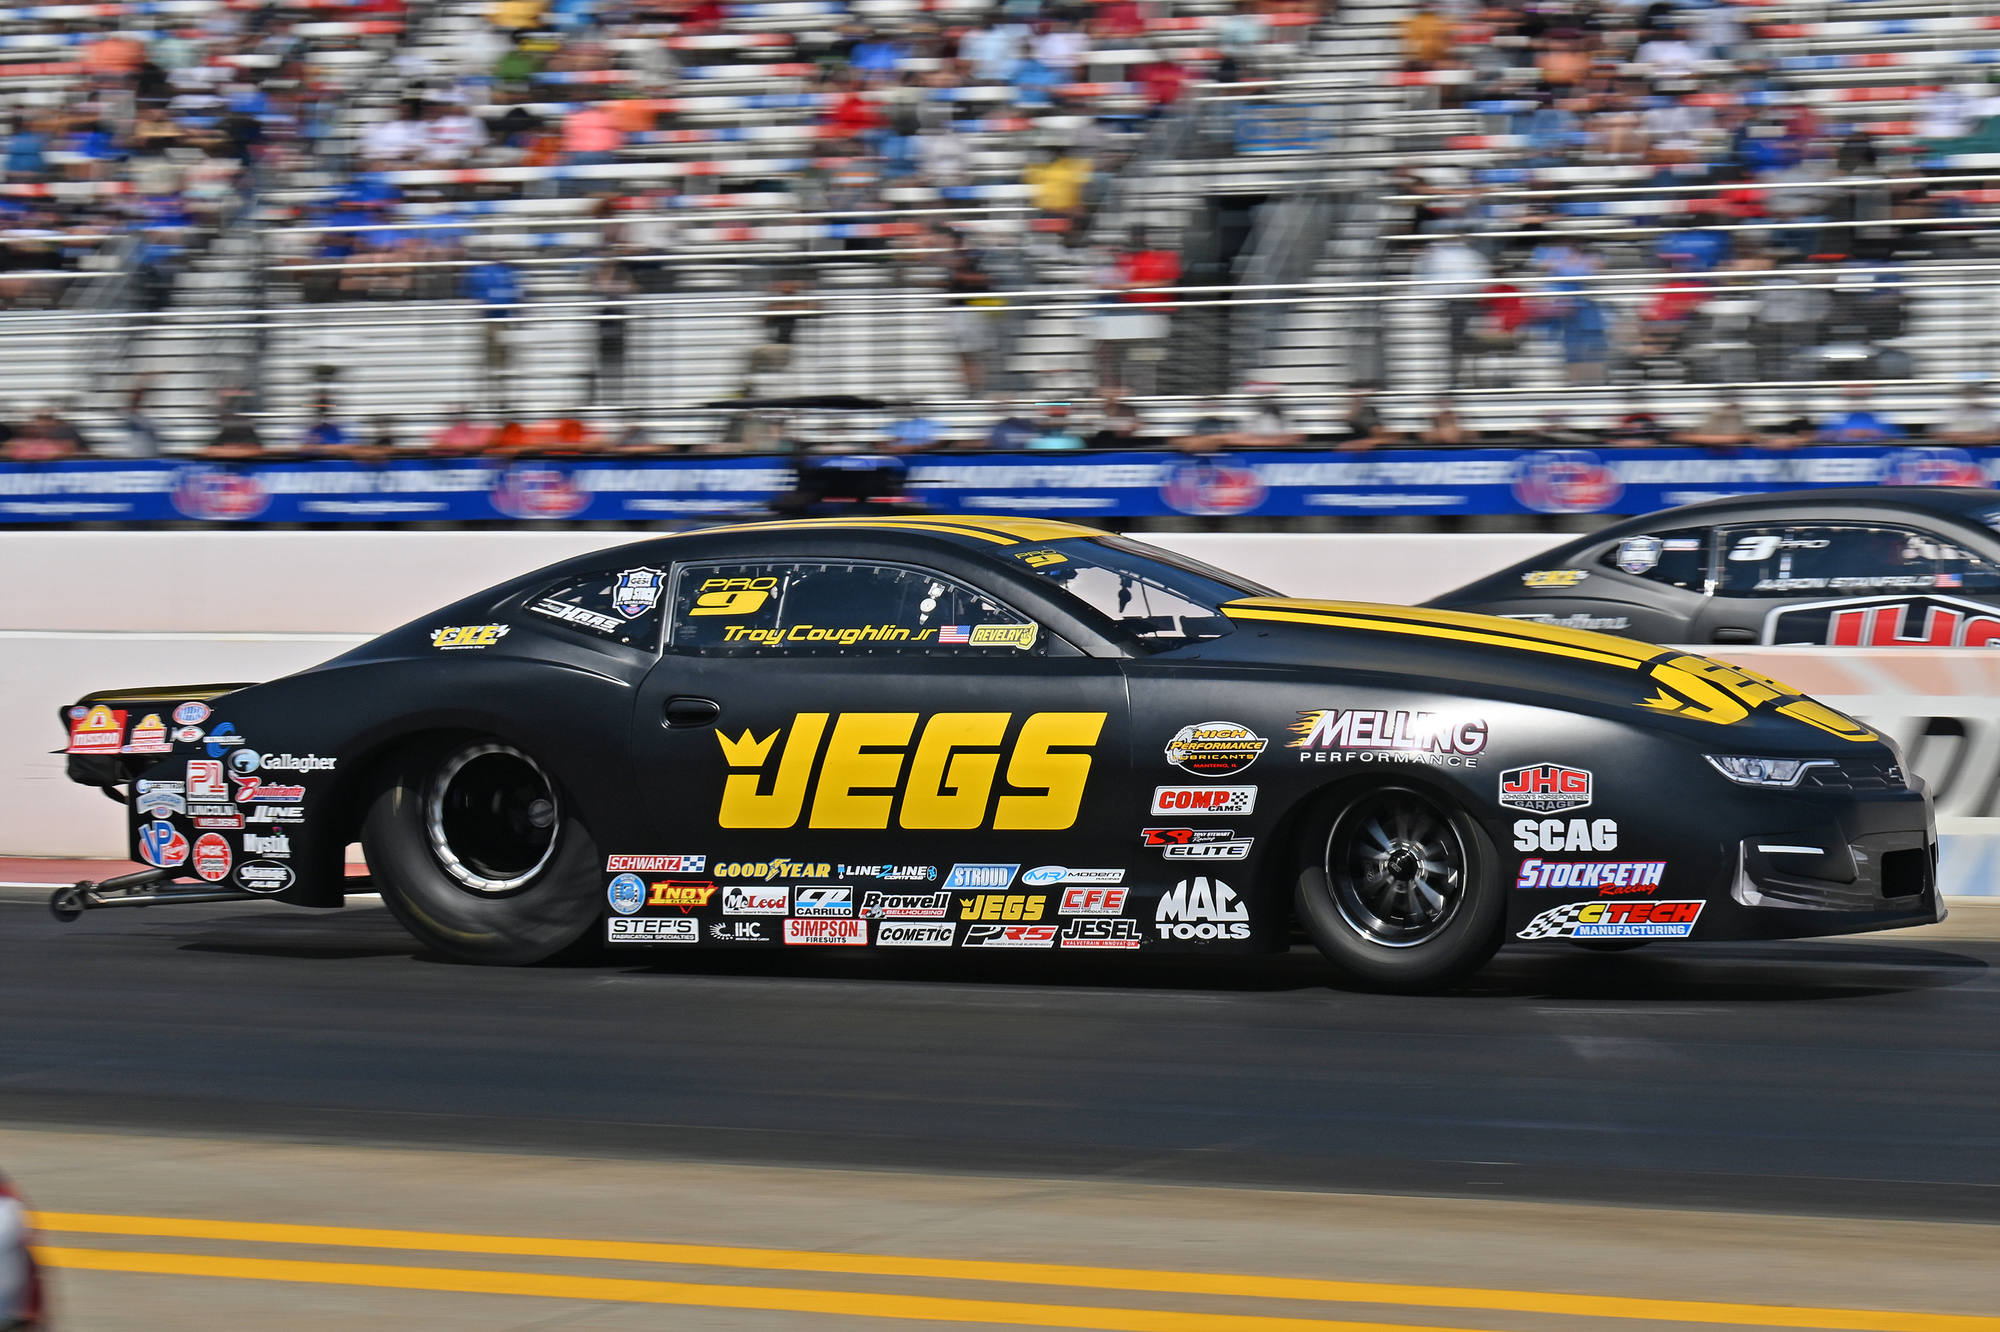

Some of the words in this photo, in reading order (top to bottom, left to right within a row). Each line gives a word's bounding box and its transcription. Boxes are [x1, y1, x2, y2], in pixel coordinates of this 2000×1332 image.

[700, 577, 778, 591] PRO
[688, 591, 769, 616] 9
[723, 625, 787, 645] Troy
[786, 624, 911, 645] Coughlin
[1194, 730, 1247, 738] HIGH
[1301, 709, 1488, 756] MELLING
[1170, 741, 1263, 750] PERFORMANCE
[260, 753, 338, 773] Gallagher
[1300, 751, 1478, 768] PERFORMANCE
[718, 712, 1108, 830] JEGS
[1504, 767, 1587, 794] JHG
[1159, 791, 1231, 809] COMP
[1514, 800, 1576, 811] GARAGE
[1513, 818, 1618, 852] SCAG
[1169, 846, 1246, 855] ELITE
[610, 857, 680, 870] SCHWARTZ
[845, 864, 928, 879] LINE2LINE
[955, 867, 1009, 888] STROUD
[1517, 858, 1667, 888] STOCKSETH
[648, 882, 718, 905] INDY
[1598, 882, 1658, 896] Racing
[727, 894, 787, 911] McLeod
[866, 892, 950, 909] Browell
[1063, 890, 1124, 908] CFE
[1155, 876, 1250, 921] MAC
[960, 895, 1047, 920] JEGS
[613, 919, 693, 933] STEF'S
[735, 922, 760, 937] IHC
[790, 920, 859, 937] SIMPSON
[1062, 919, 1140, 939] JESEL
[1155, 923, 1251, 939] TOOLS
[1579, 925, 1686, 935] MANUFACTURING
[880, 928, 952, 942] COMETIC
